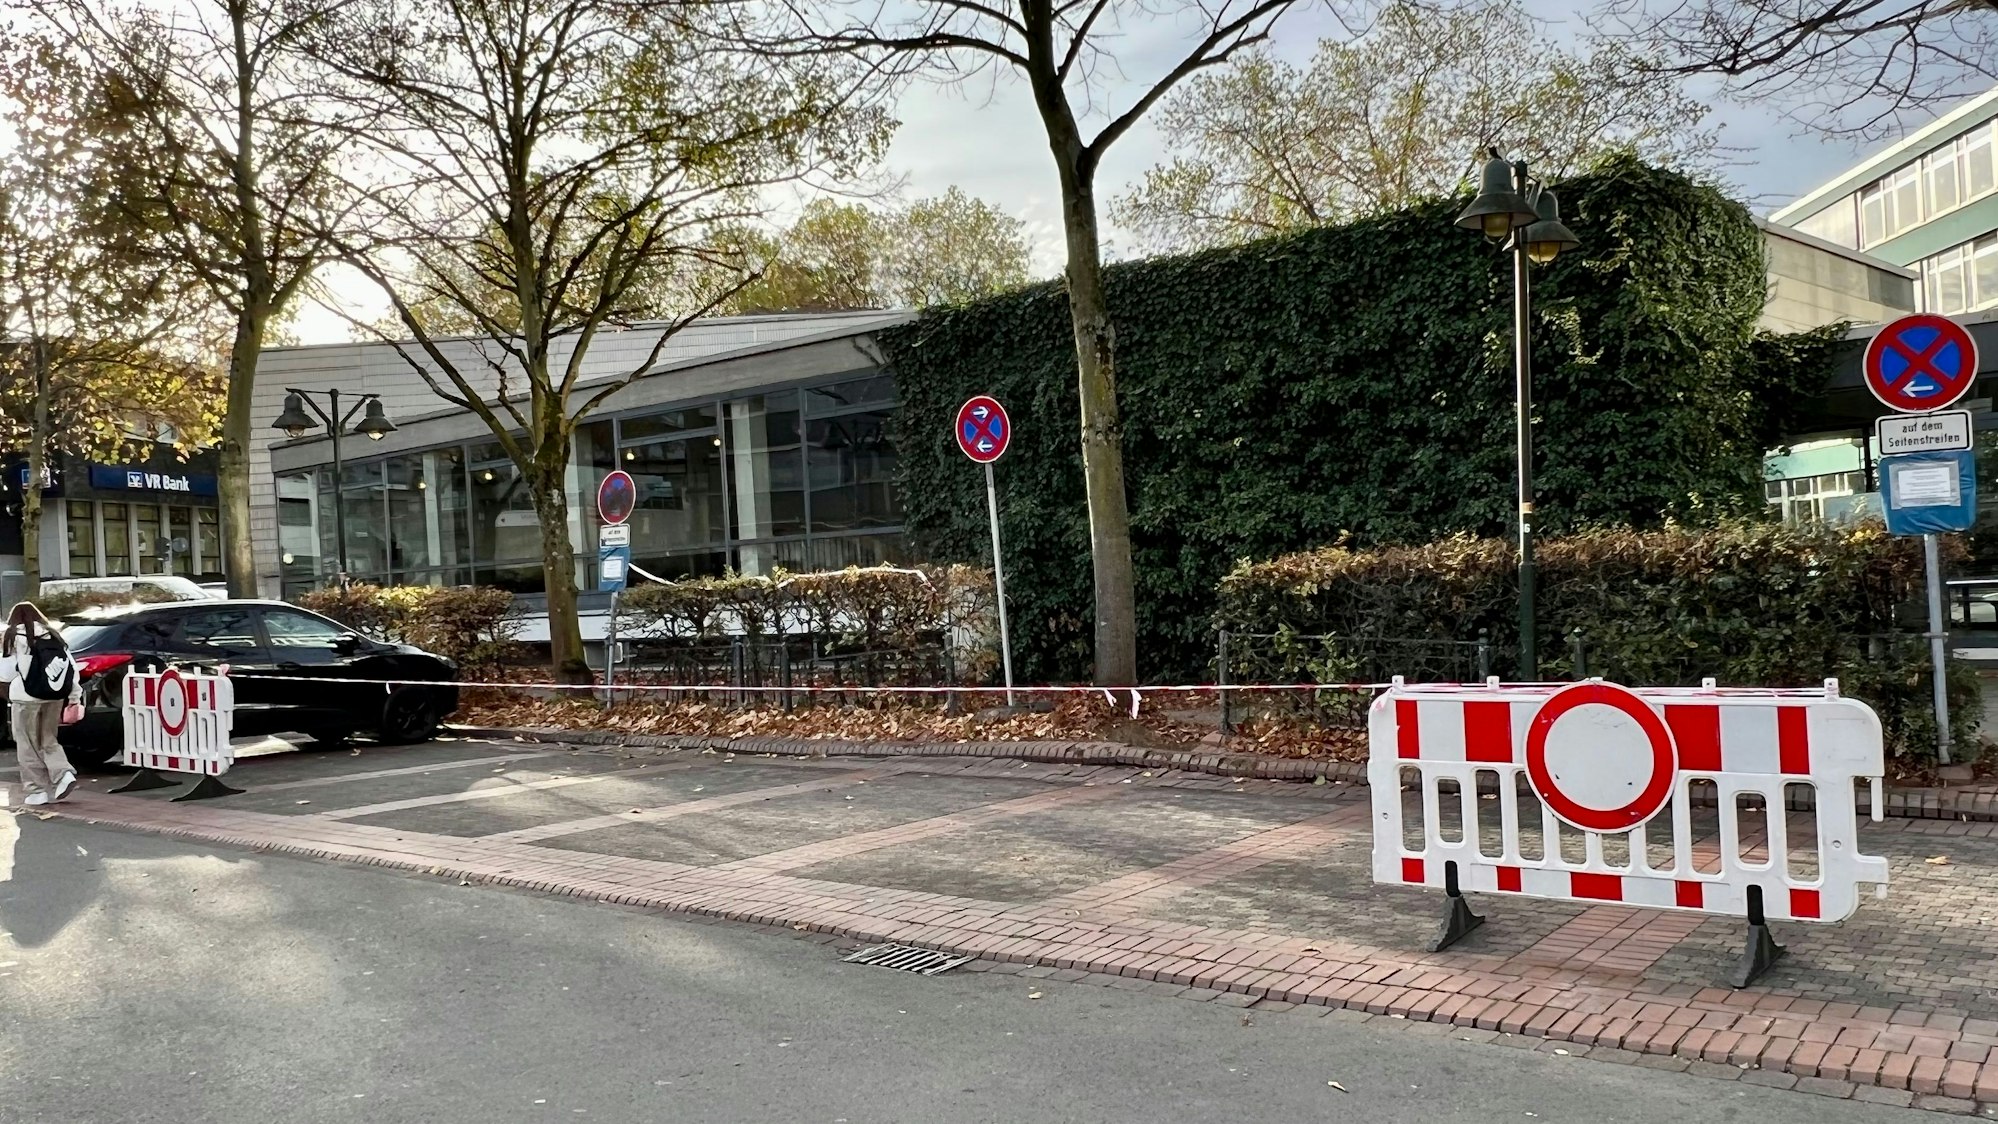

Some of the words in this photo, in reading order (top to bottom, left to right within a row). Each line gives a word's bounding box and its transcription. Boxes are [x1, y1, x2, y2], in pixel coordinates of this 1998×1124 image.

[1902, 422, 1917, 433] auf
[1921, 421, 1943, 432] dem
[1888, 433, 1960, 447] Seitenstreifen
[144, 473, 161, 489] VR
[162, 474, 190, 491] Bank
